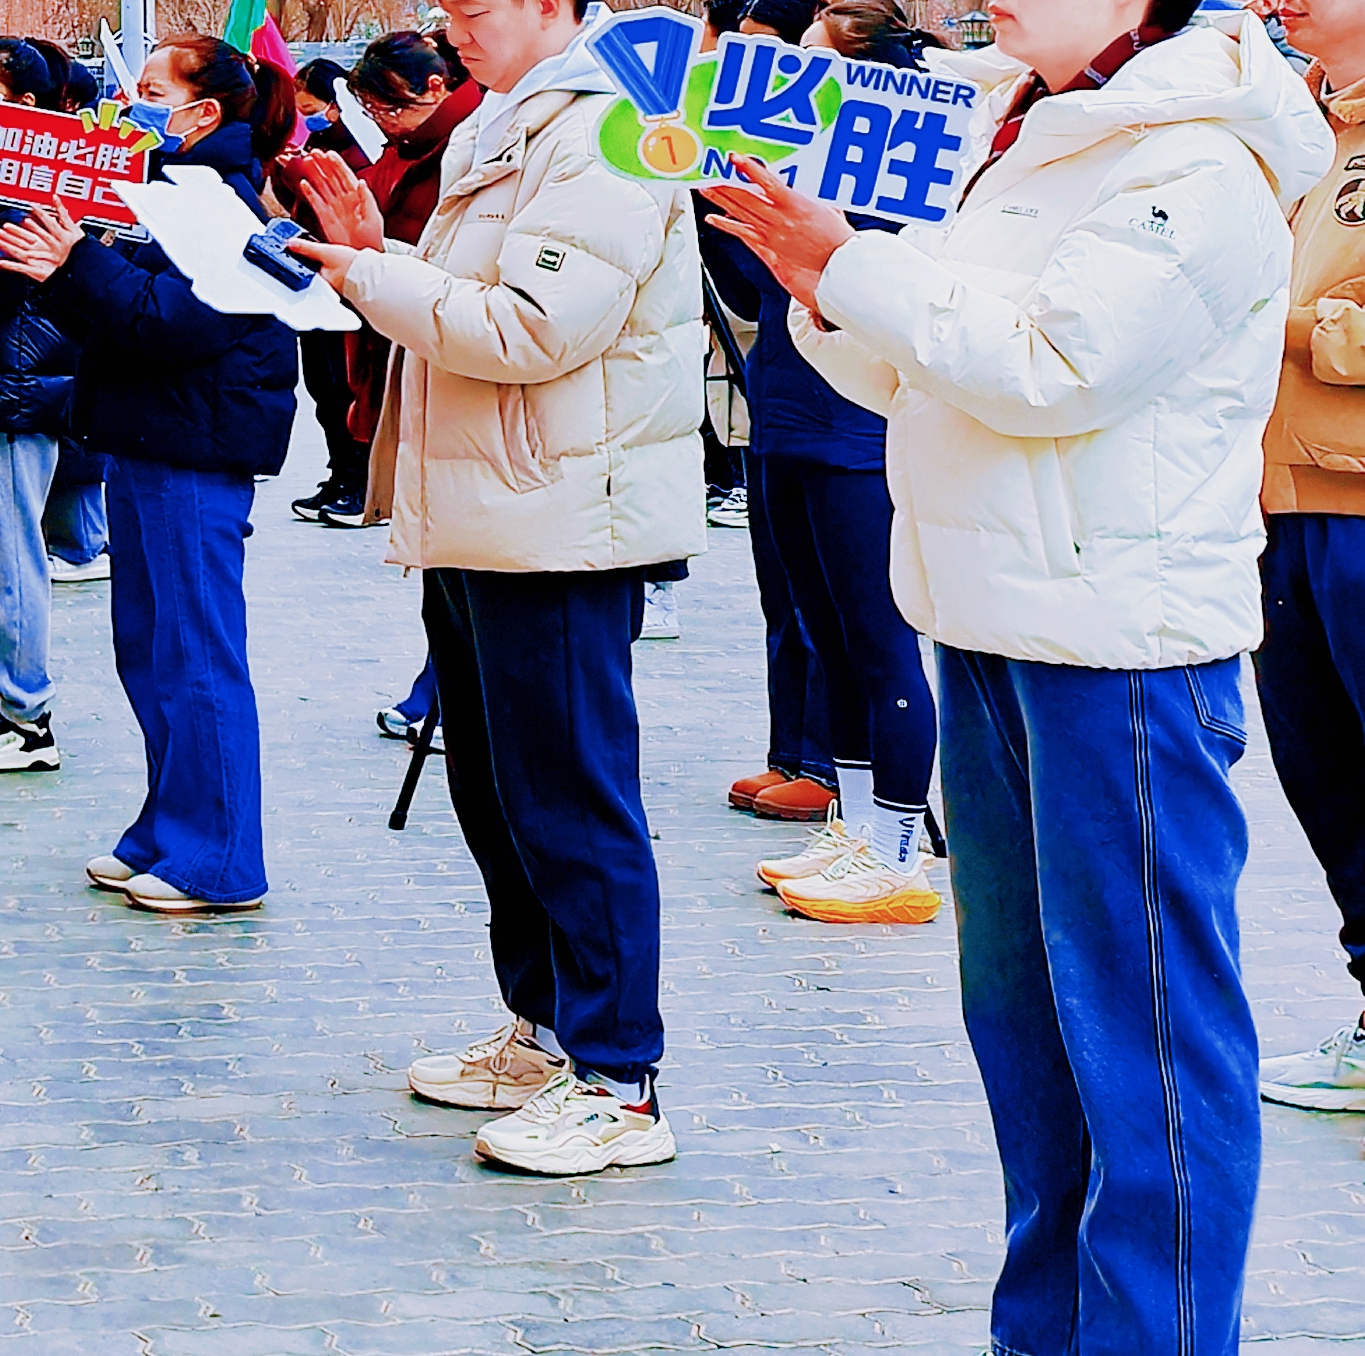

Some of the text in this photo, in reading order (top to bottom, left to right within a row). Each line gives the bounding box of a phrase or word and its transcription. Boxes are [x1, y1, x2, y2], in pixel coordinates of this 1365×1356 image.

[846, 62, 977, 109] WINNER
[707, 41, 963, 222] 必胜
[1128, 217, 1177, 241] CAMEL
